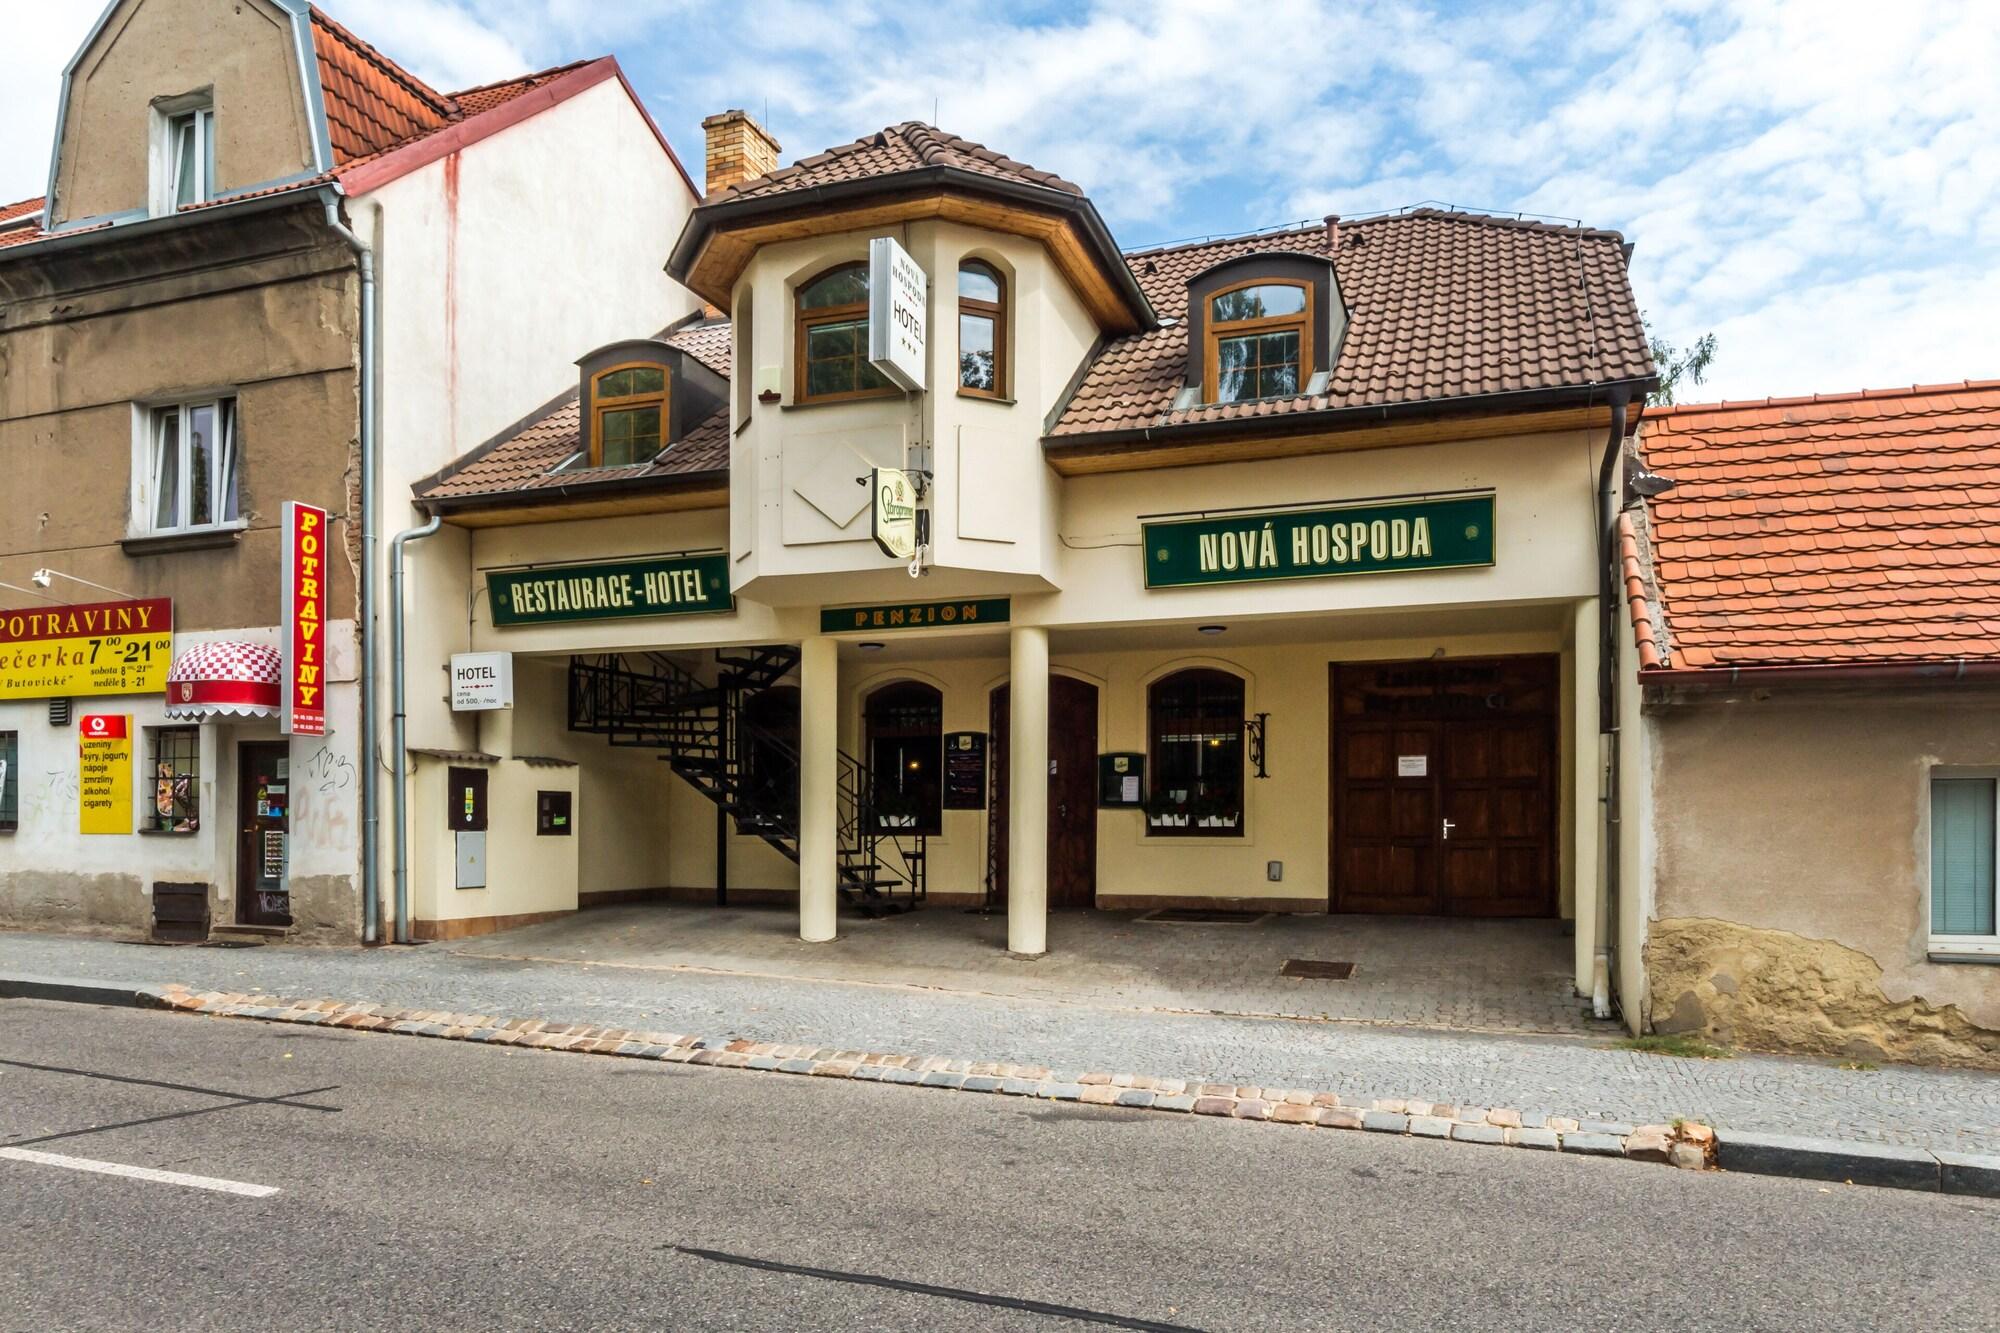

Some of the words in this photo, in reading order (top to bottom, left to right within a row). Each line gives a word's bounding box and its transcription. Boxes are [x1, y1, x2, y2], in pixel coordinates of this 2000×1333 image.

[892, 264, 926, 308] HOSPODA
[894, 299, 924, 345] HOTEL
[882, 485, 913, 523] Staropram
[1199, 522, 1278, 573] NOVÁ
[1292, 516, 1433, 566] HOSPODA
[299, 511, 319, 706] POTRAVINY
[855, 604, 978, 627] PENZION
[0, 606, 153, 638] POTRAVINY
[0, 646, 85, 670] ečerka
[90, 666, 118, 676] sobota
[457, 666, 496, 680] HOTEL
[93, 678, 119, 688] neděle
[83, 741, 112, 750] uzeniny
[102, 752, 128, 762] jogurty
[83, 787, 110, 796] alkohol
[83, 799, 112, 809] cigarety
